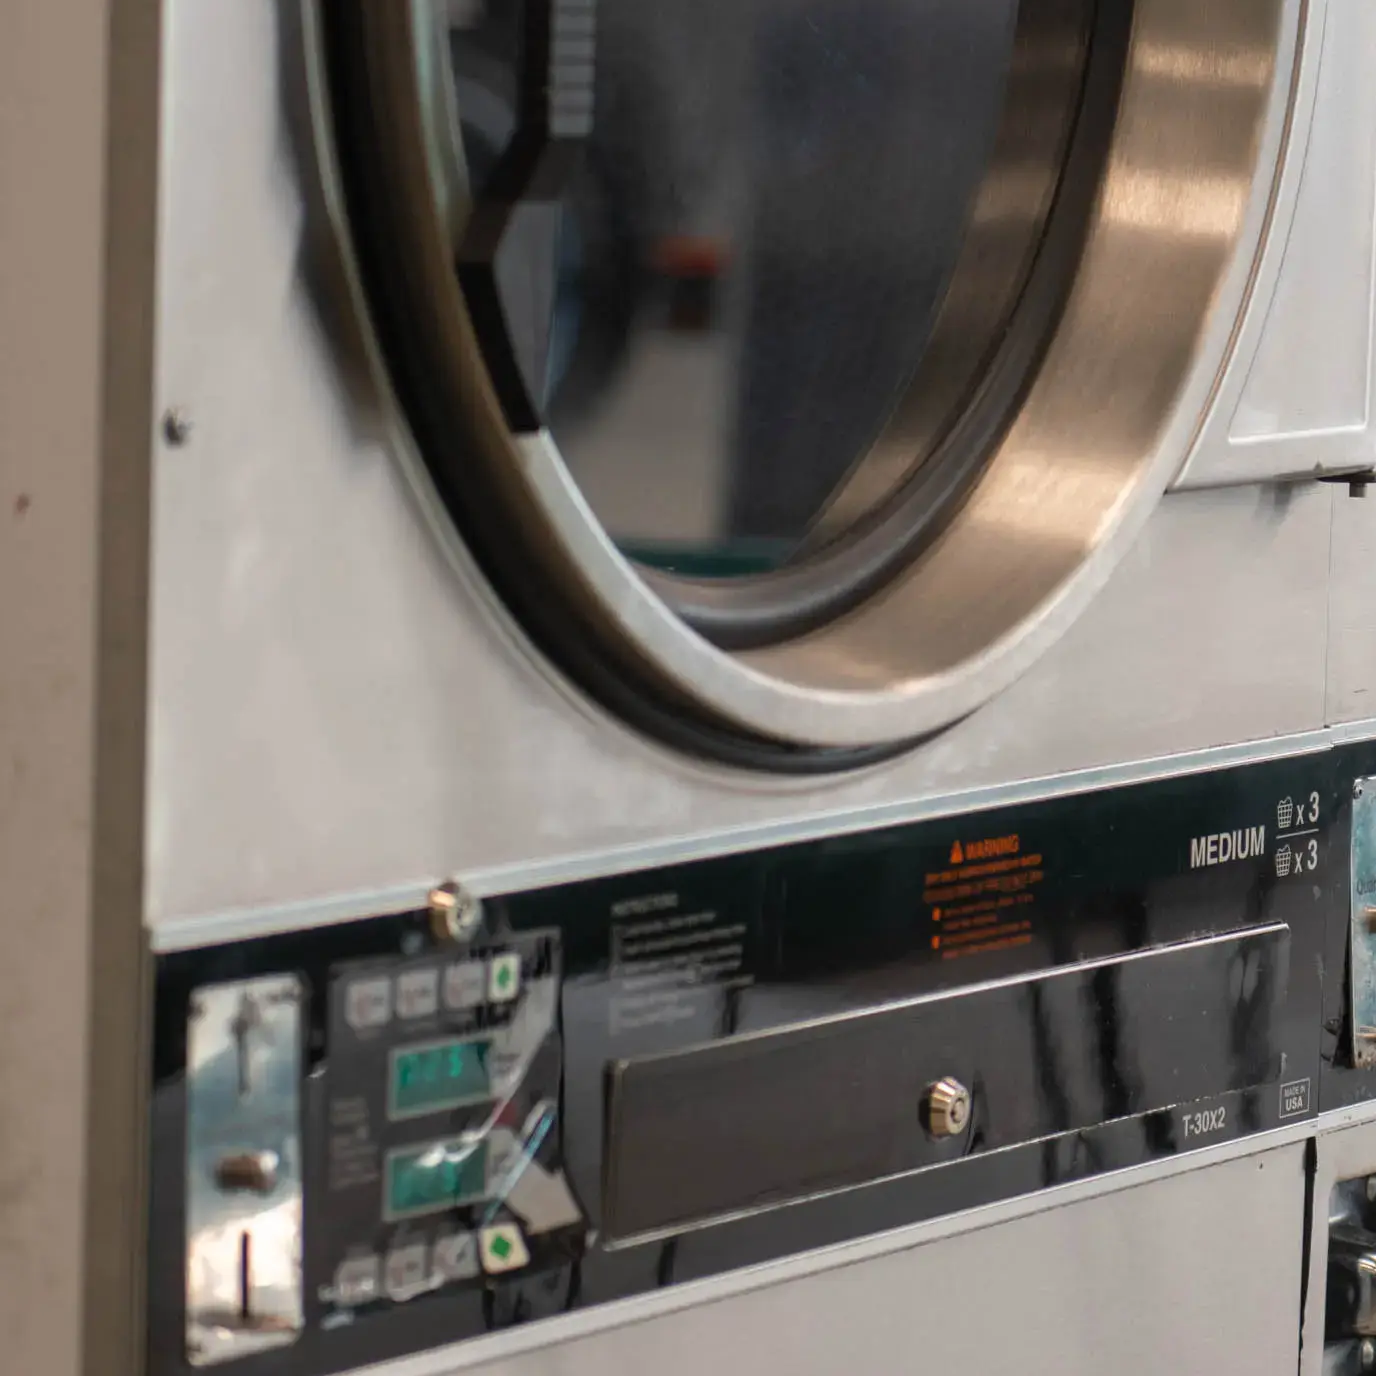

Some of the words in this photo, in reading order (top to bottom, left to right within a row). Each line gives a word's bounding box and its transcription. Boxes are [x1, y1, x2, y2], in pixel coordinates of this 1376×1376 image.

[1308, 791, 1320, 823] 3
[1190, 825, 1265, 869] MEDIUM
[1307, 839, 1318, 871] 3
[1285, 1096, 1303, 1112] USA
[1182, 1106, 1226, 1138] T-30X2
